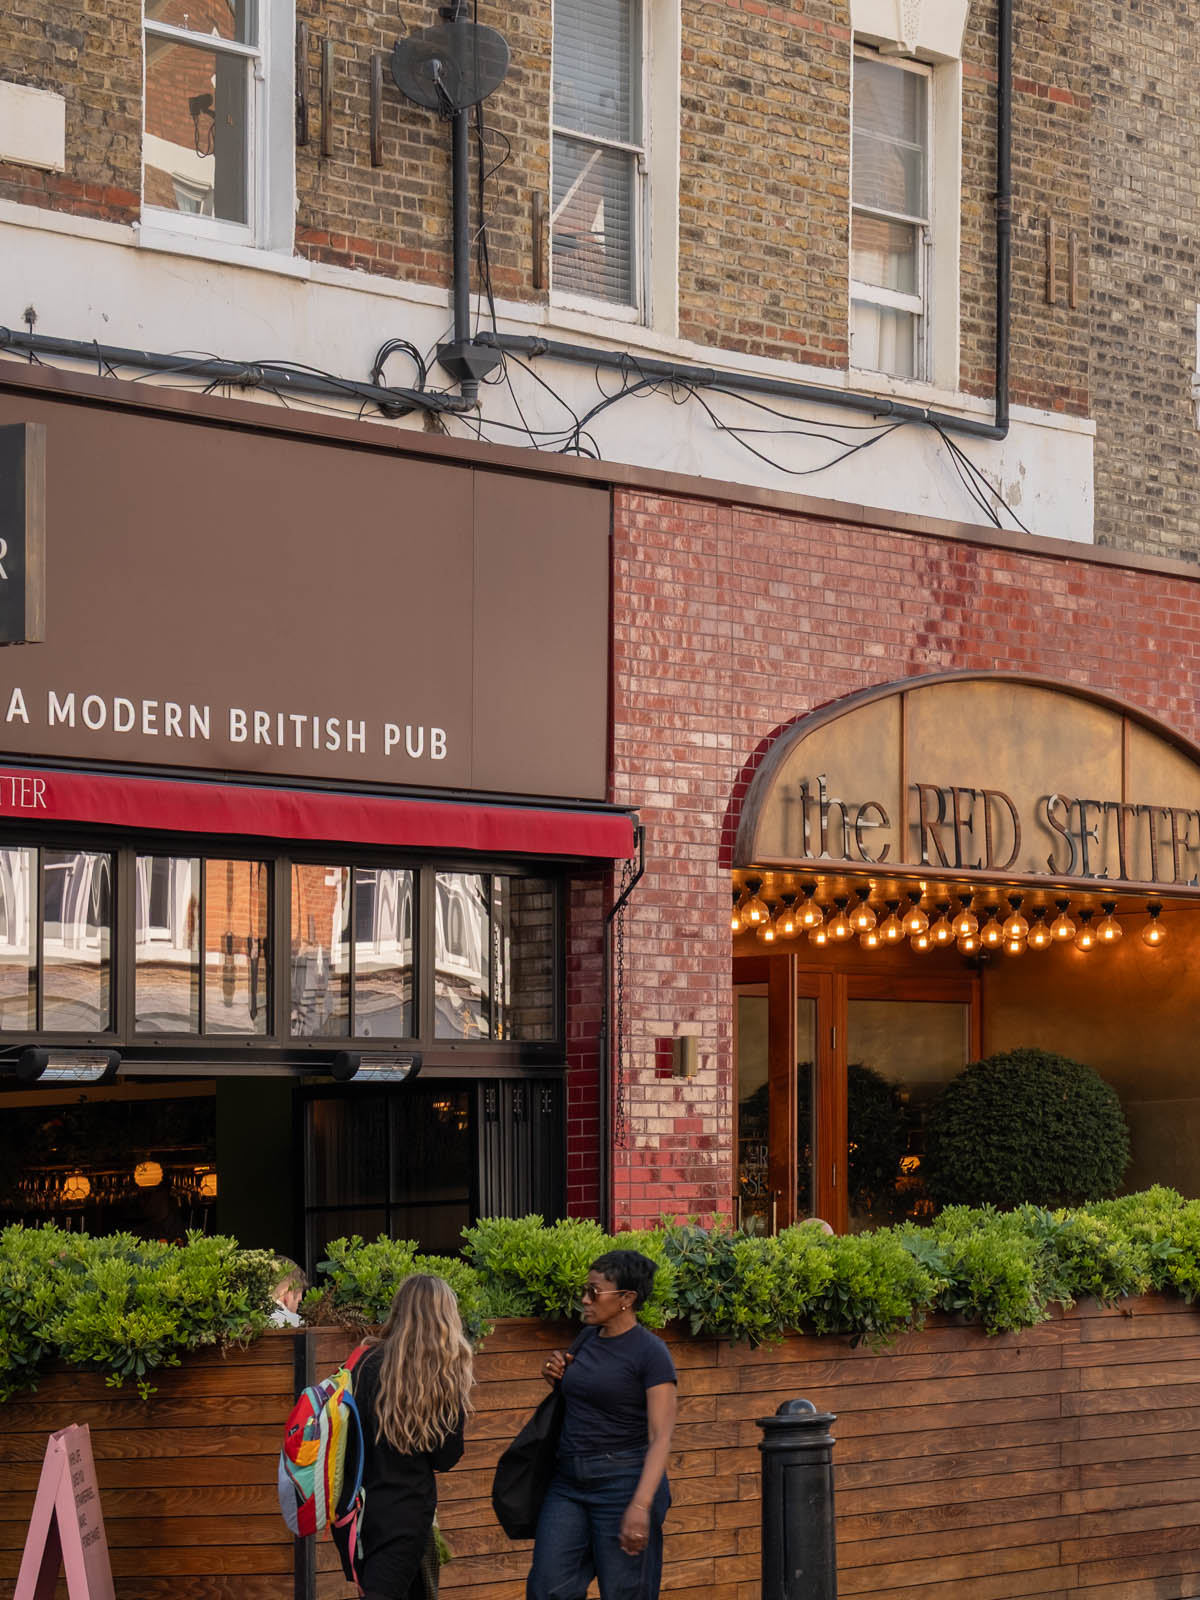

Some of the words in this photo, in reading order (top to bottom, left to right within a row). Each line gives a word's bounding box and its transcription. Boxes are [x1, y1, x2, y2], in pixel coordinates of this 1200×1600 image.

[6, 688, 30, 723] A
[48, 690, 210, 740] MODERN
[229, 708, 366, 753] BRITISH
[384, 723, 448, 760] PUB
[800, 774, 891, 864] the
[916, 783, 1021, 872] RED
